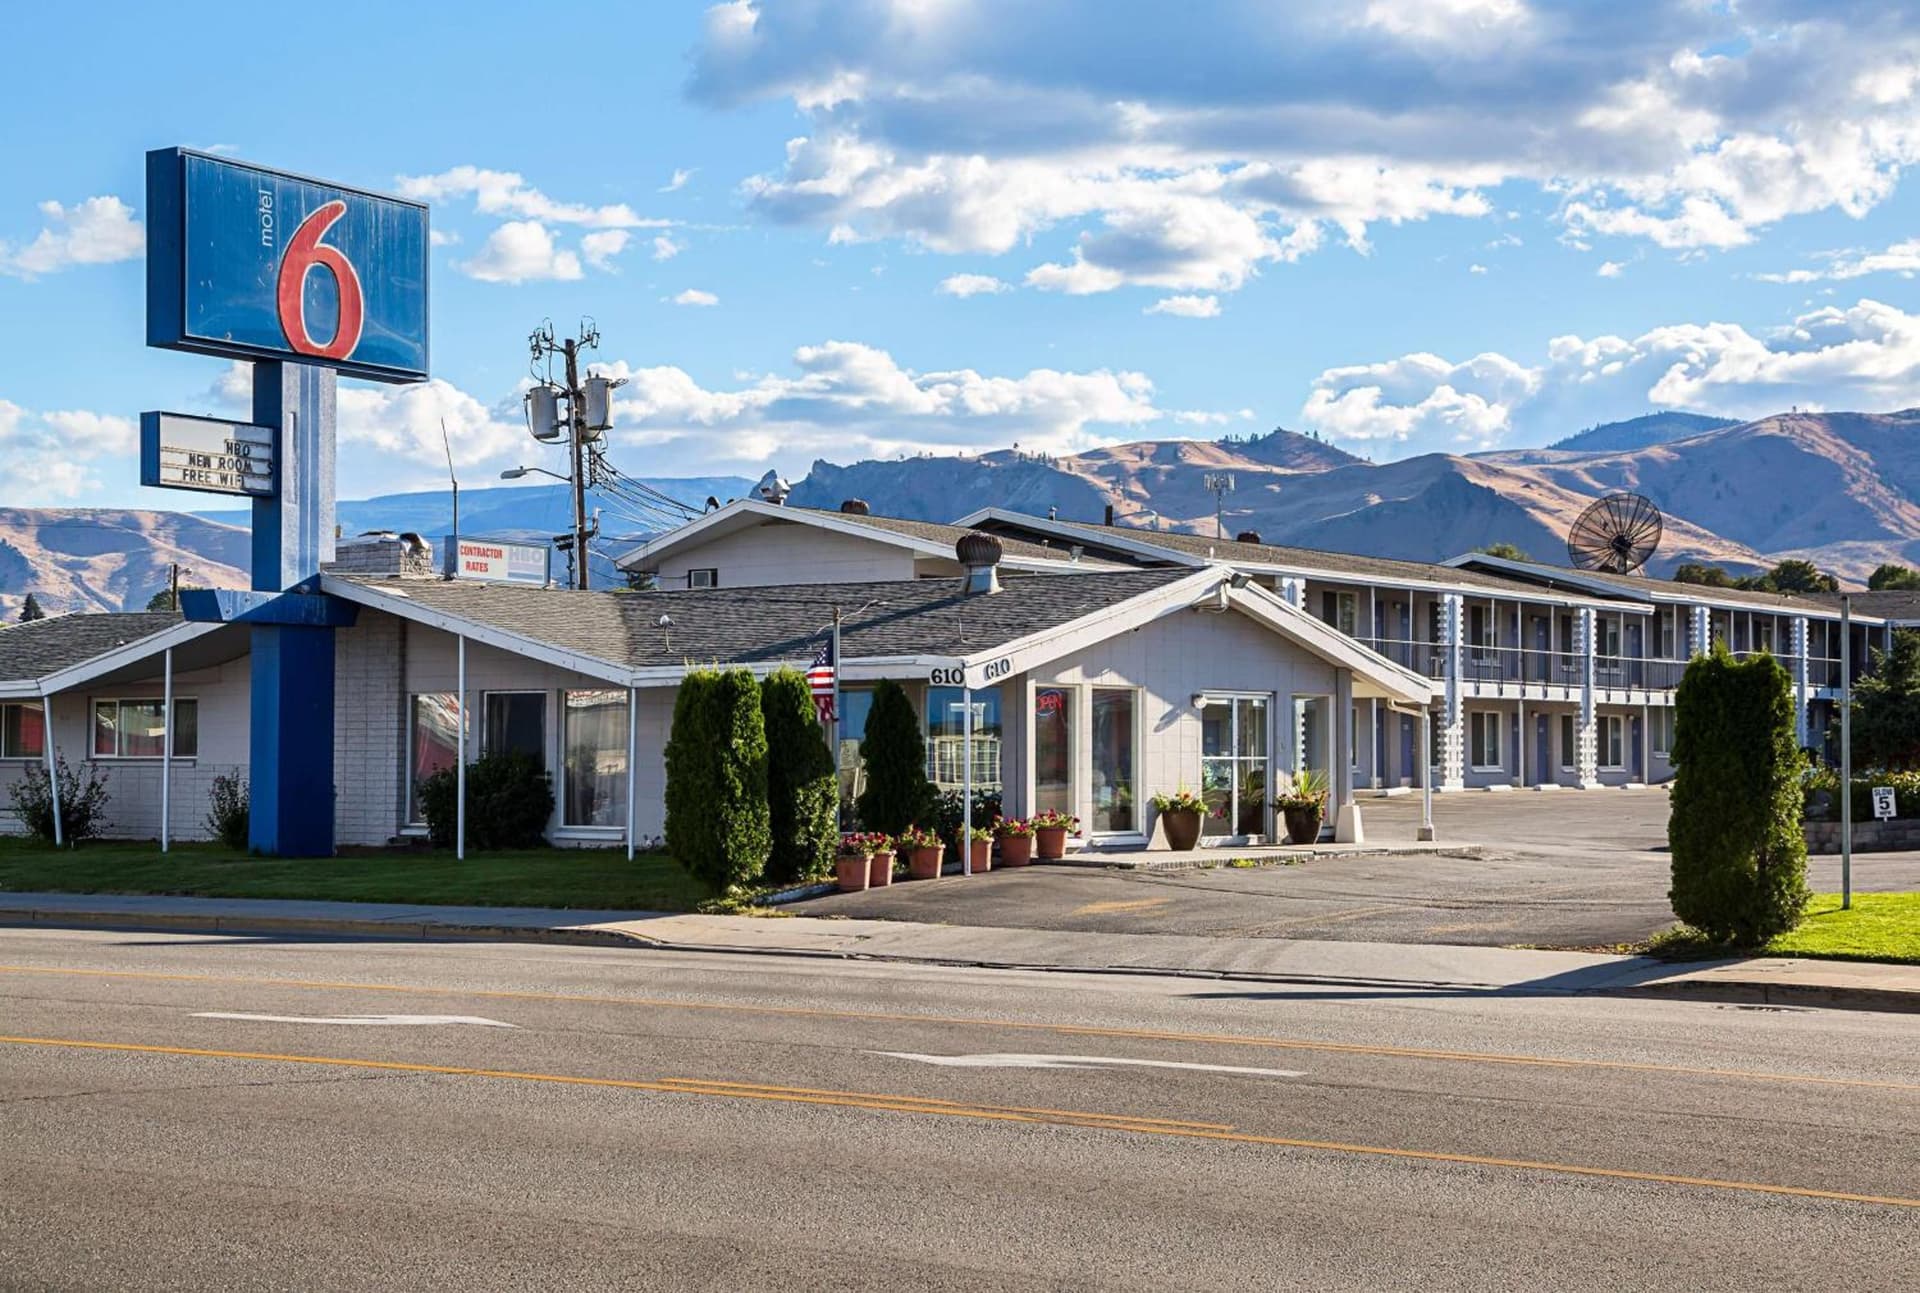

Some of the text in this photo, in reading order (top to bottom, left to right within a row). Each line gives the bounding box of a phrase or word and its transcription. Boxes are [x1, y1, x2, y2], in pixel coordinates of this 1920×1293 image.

[258, 189, 273, 247] motel
[276, 200, 364, 360] 6
[226, 441, 251, 457] HBO
[183, 468, 245, 488] FREE WIFI
[460, 545, 503, 560] CONTRACTOR
[465, 561, 489, 573] RATES
[931, 668, 965, 685] 610
[984, 659, 1011, 681] 610
[1879, 796, 1890, 810] 5
